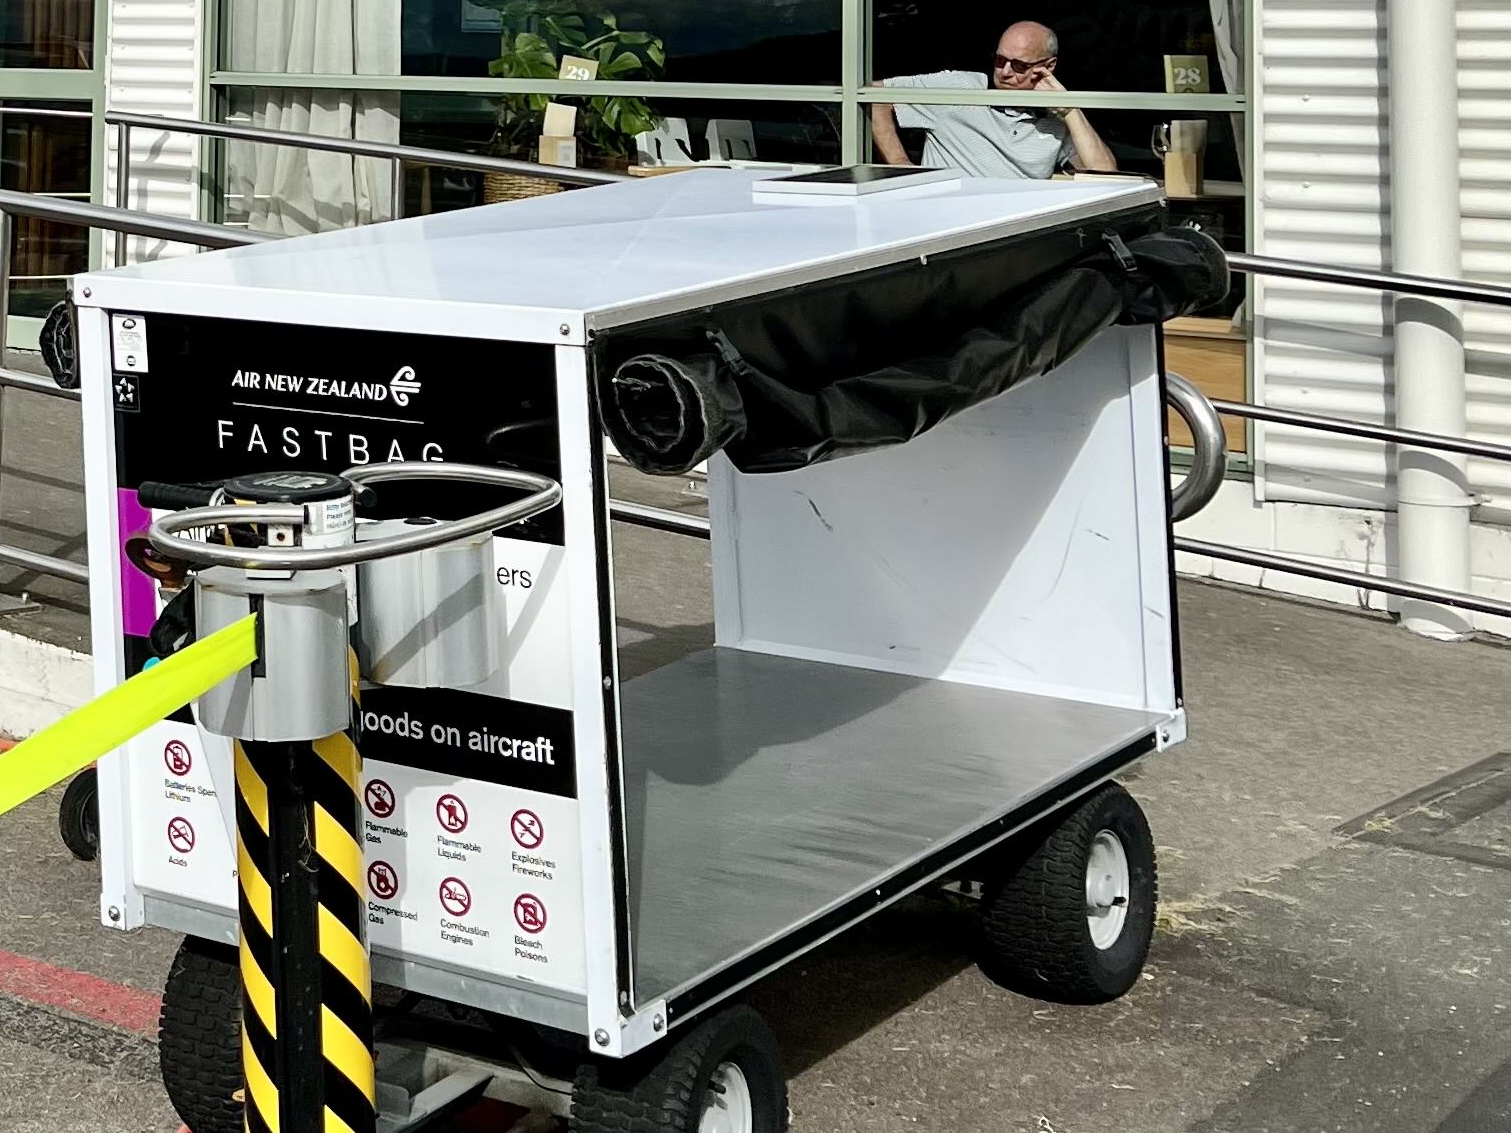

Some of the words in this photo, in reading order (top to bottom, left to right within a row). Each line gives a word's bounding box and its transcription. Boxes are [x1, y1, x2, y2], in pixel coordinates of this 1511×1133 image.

[565, 65, 590, 80] 29
[1174, 67, 1201, 85] 28
[231, 369, 261, 389] AIR
[265, 373, 303, 393] NEW
[306, 377, 388, 401] ZEALAND
[217, 419, 444, 465] FASTBAG
[430, 724, 461, 747] on
[468, 726, 555, 765] aircraft
[365, 832, 382, 844] Gas
[437, 834, 482, 854] Flammable
[438, 848, 467, 862] Liquids
[511, 850, 556, 869] Explosives
[512, 863, 553, 880] Fireworks
[368, 901, 418, 921] Compressed
[368, 913, 384, 925] Gas
[440, 918, 490, 938] Combustion
[441, 930, 473, 947] Engines
[514, 947, 549, 964] Poisons
